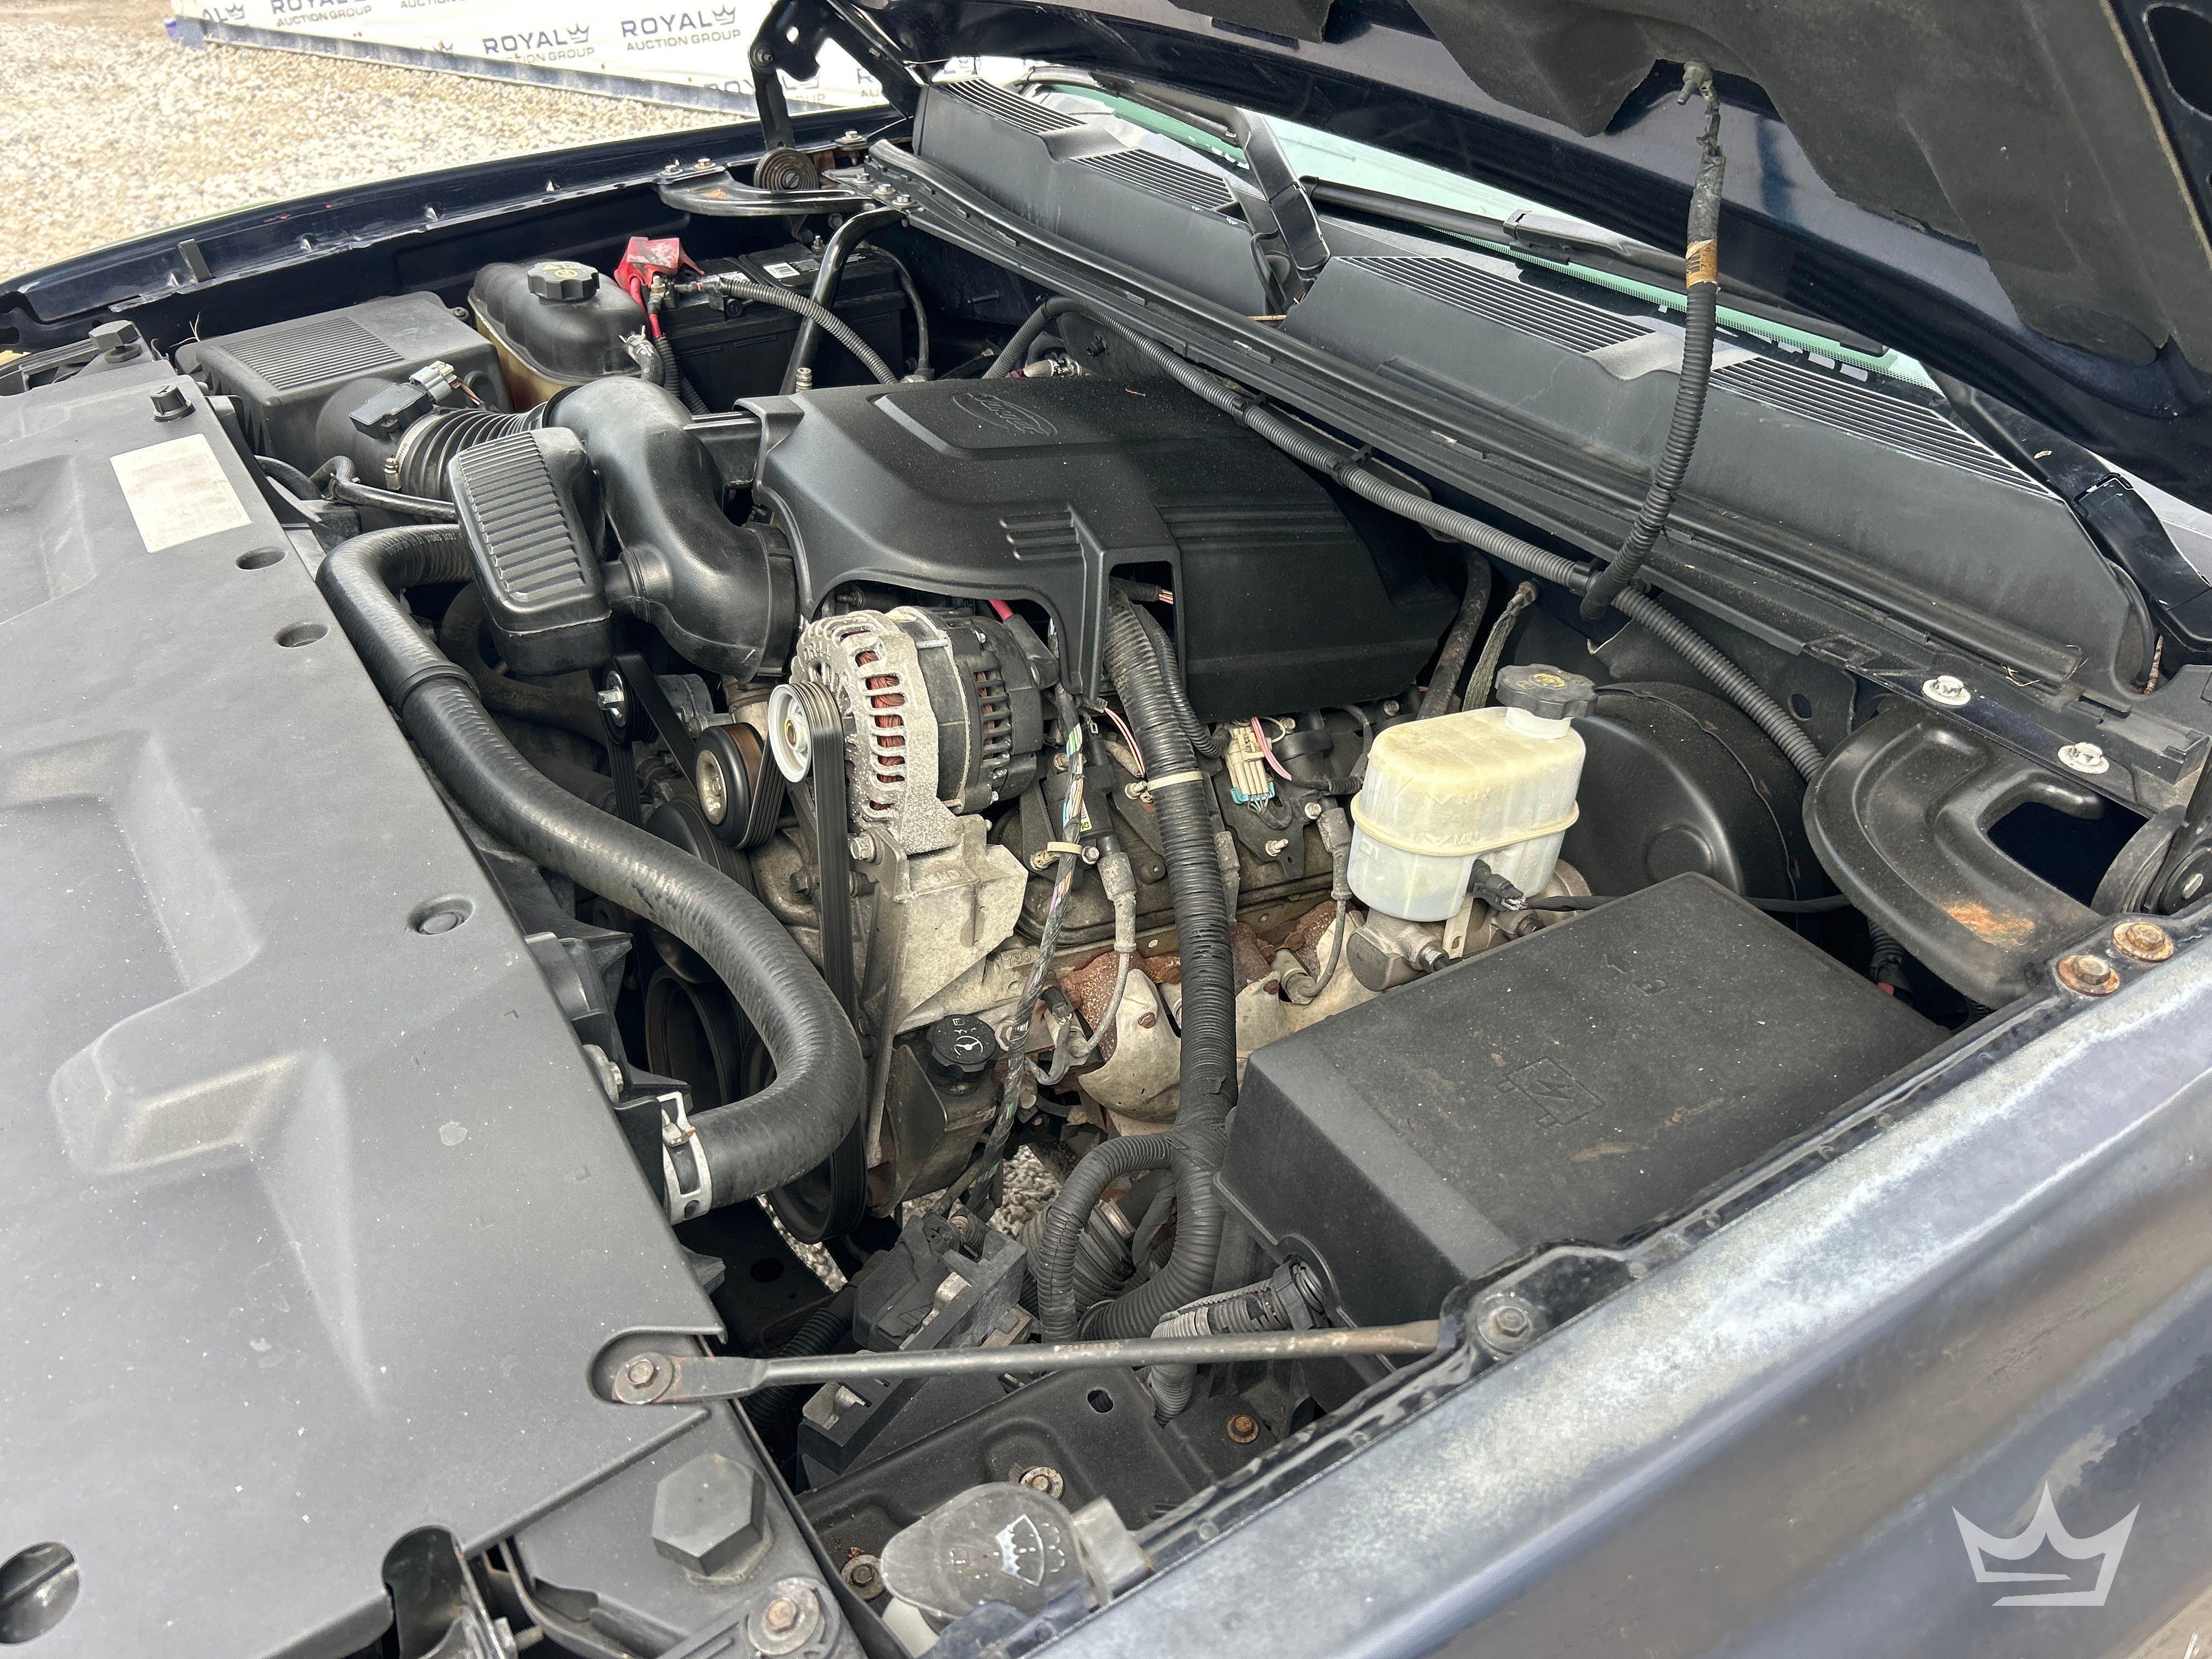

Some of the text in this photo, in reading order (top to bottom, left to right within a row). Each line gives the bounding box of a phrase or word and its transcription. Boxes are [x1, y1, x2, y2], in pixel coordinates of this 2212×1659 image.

[276, 5, 372, 27] AUCTION GROUP
[620, 11, 713, 37] ROYAL
[482, 29, 568, 54] ROYAL
[627, 29, 741, 51] AUCTION GROUP
[549, 47, 595, 61] GROUP
[1002, 950, 1031, 966] 799
